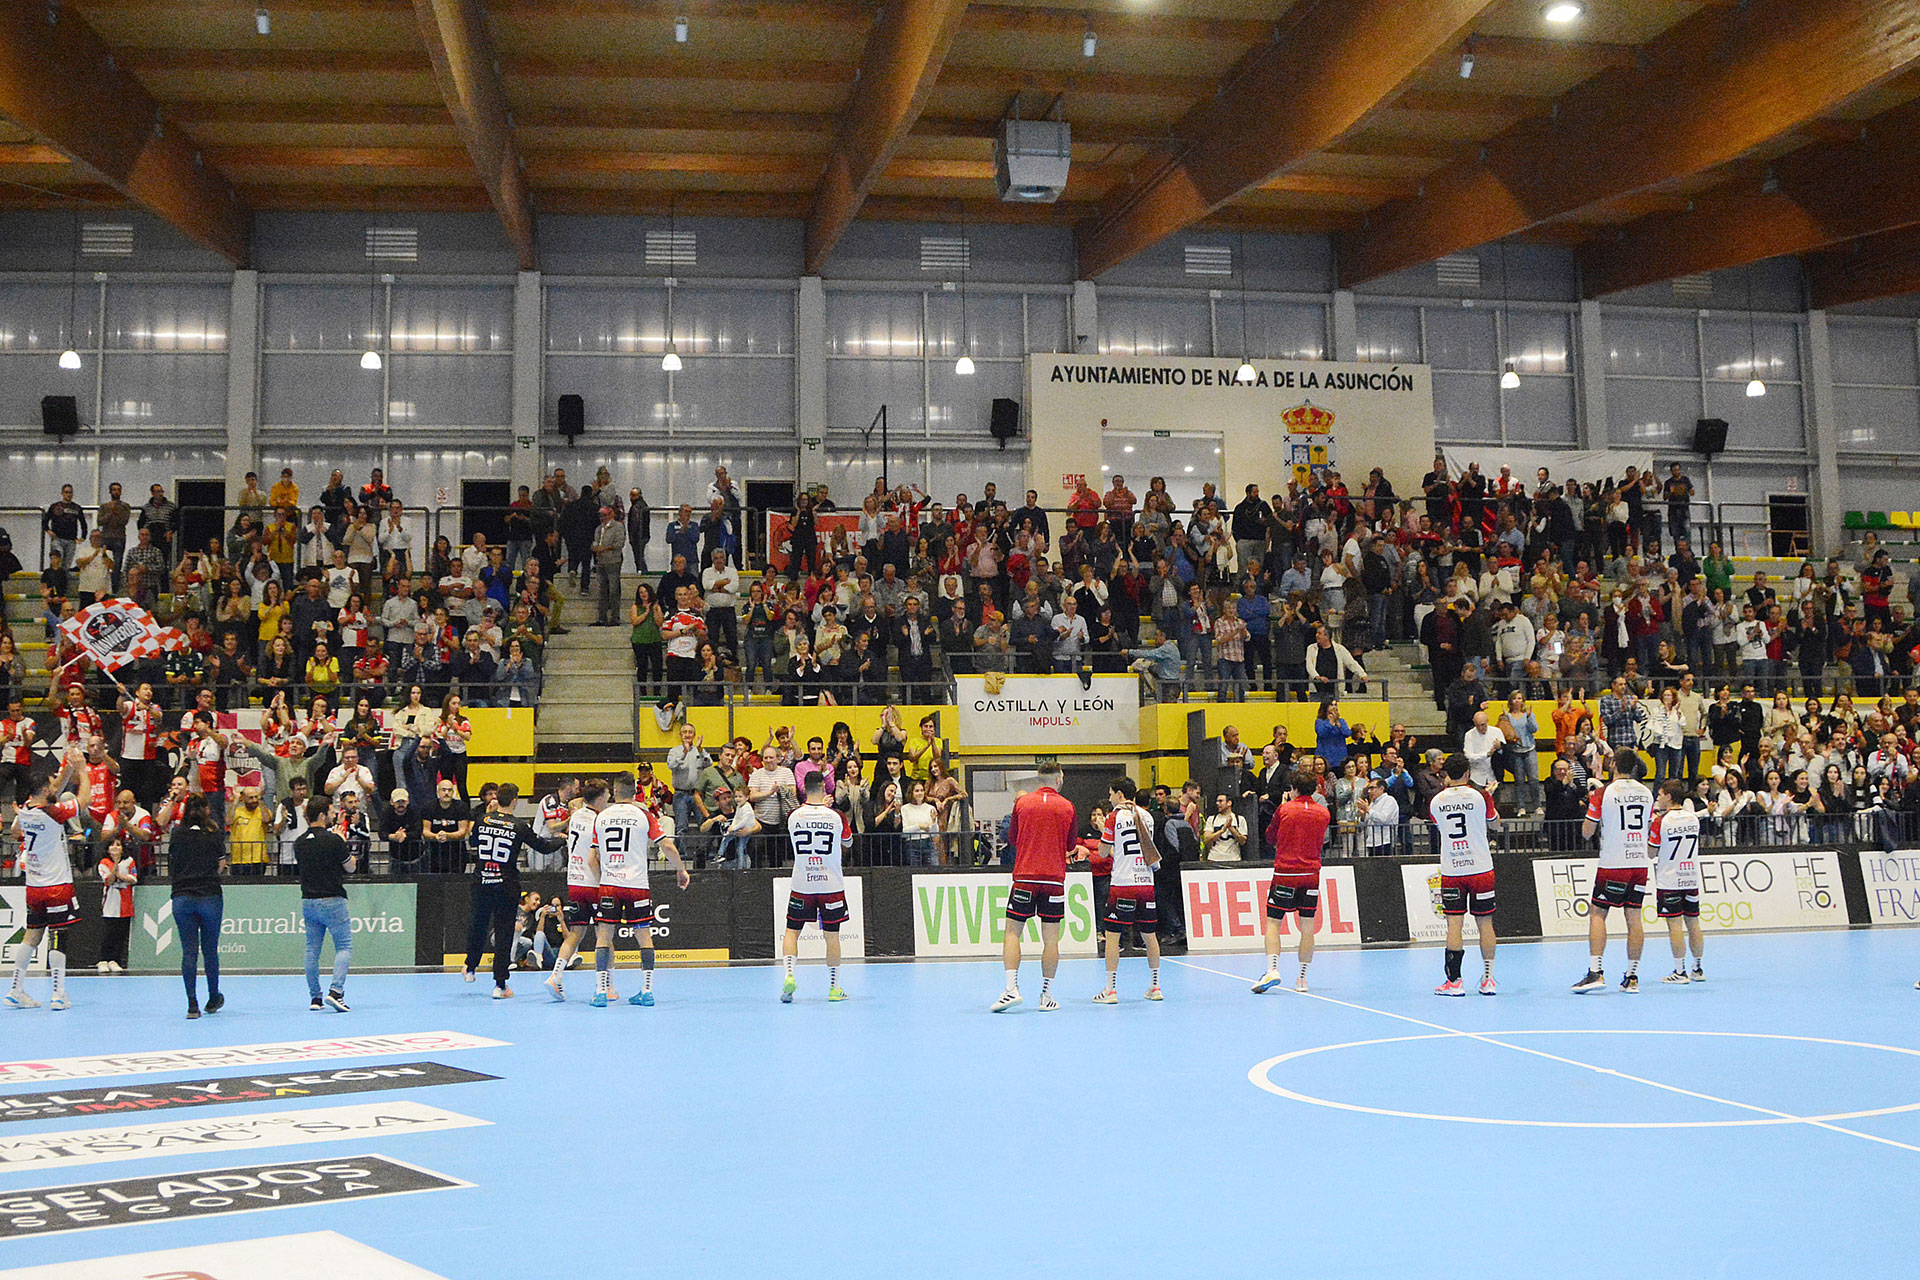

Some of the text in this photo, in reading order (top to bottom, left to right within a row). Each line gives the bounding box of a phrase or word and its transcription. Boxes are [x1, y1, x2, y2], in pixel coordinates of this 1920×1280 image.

[1050, 365, 1413, 391] AYUNTAMIENTO DE NAA DE LA ASUNCIÓN
[974, 695, 1114, 714] CASTILLA Y LEÓN
[1029, 716, 1080, 728] IMPULSA
[1439, 803, 1474, 812] MOYANO
[1619, 804, 1644, 830] 13
[478, 826, 517, 839] GUITERAS
[609, 816, 638, 827] PÉREZ
[1446, 812, 1467, 839] 3
[26, 831, 37, 851] 7
[478, 834, 513, 863] 26
[571, 830, 580, 853] 7
[604, 826, 631, 853] 21
[793, 830, 834, 855] 23
[1668, 834, 1698, 860] 77
[917, 883, 1092, 945] VIVES
[618, 926, 670, 938] GPO
[78, 1036, 451, 1067] Tabladillo
[175, 1082, 222, 1094] Y
[250, 1067, 427, 1088] LEÓN
[74, 1088, 311, 1112] IMPULSA
[292, 1114, 449, 1135] S.A.
[11, 1180, 380, 1228] SEGOVIA
